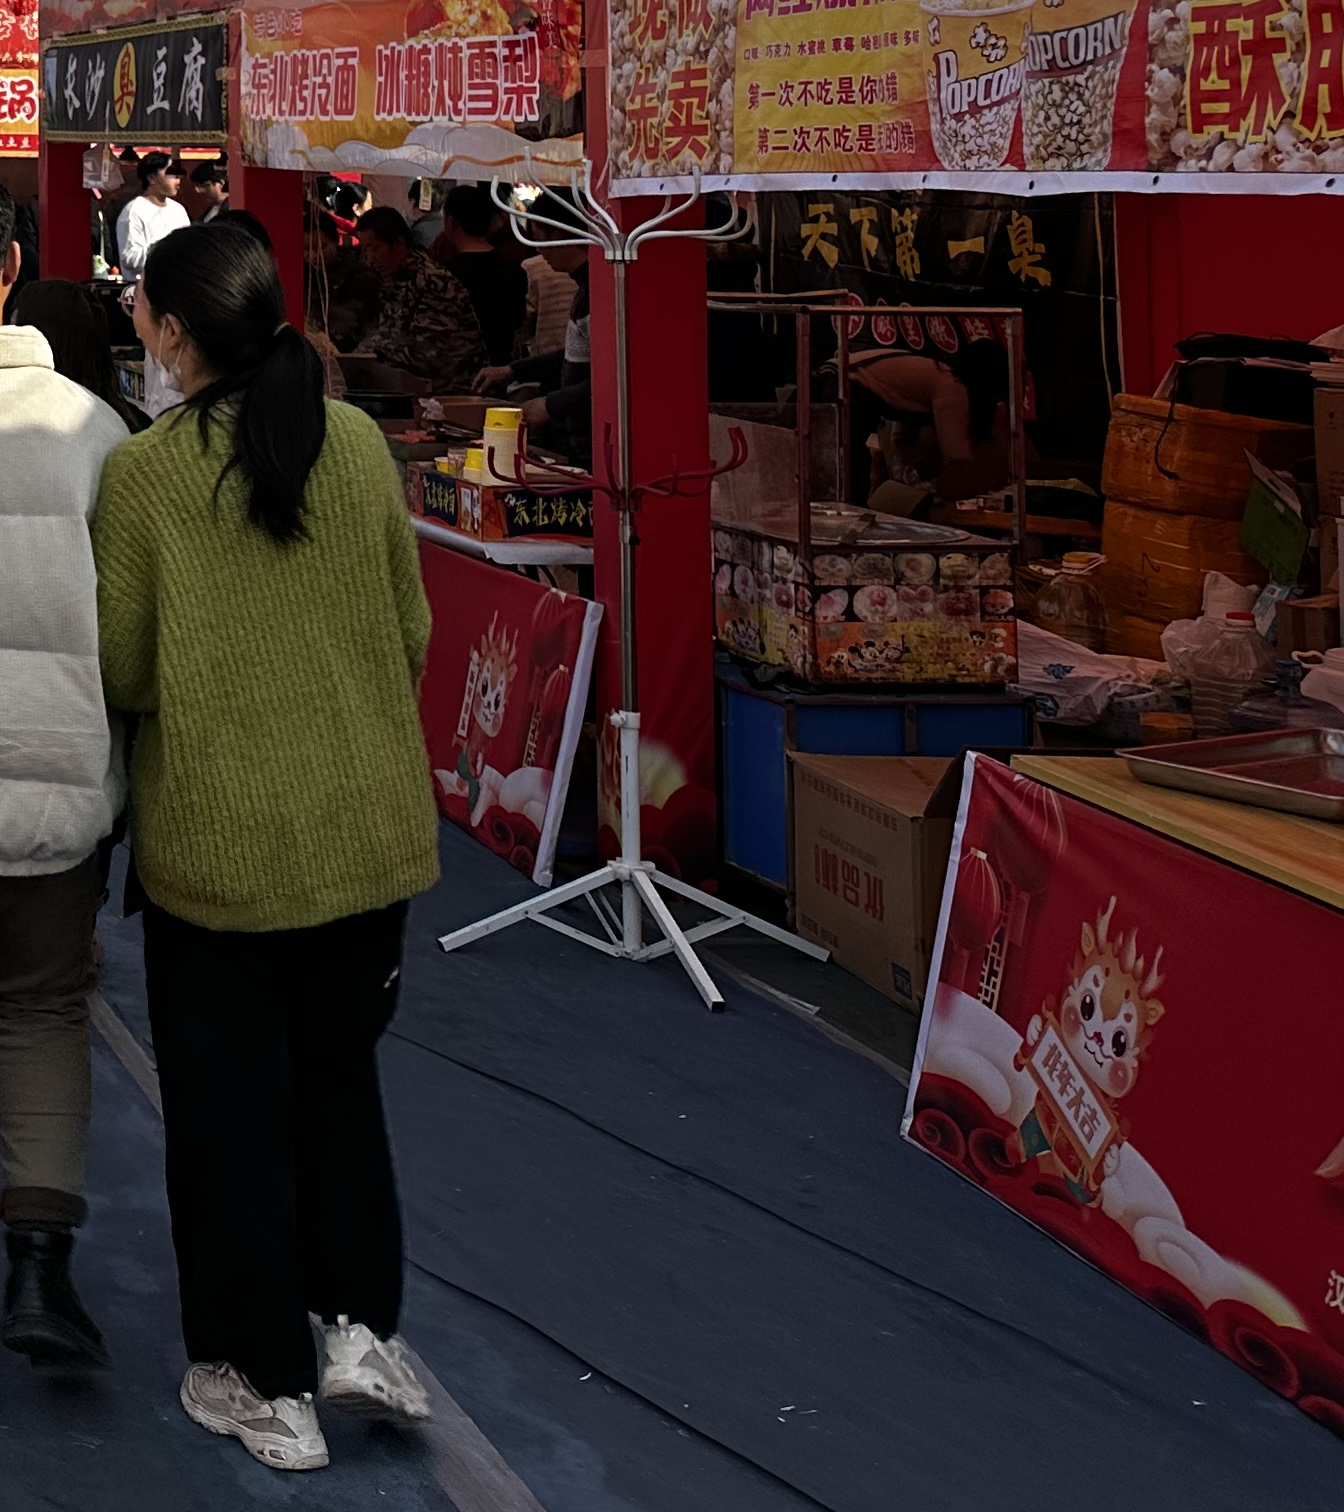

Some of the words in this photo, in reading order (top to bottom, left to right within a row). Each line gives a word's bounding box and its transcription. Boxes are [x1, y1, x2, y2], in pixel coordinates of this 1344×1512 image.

[63, 36, 207, 125] 长沙臭豆腐
[249, 46, 360, 121] 东北烤冷面
[373, 31, 540, 123] 冰糖炖雪梨
[756, 119, 916, 156] 第二次不吃是的错
[800, 203, 1052, 287] 天下第一臭
[513, 496, 593, 528] 东北烤冷
